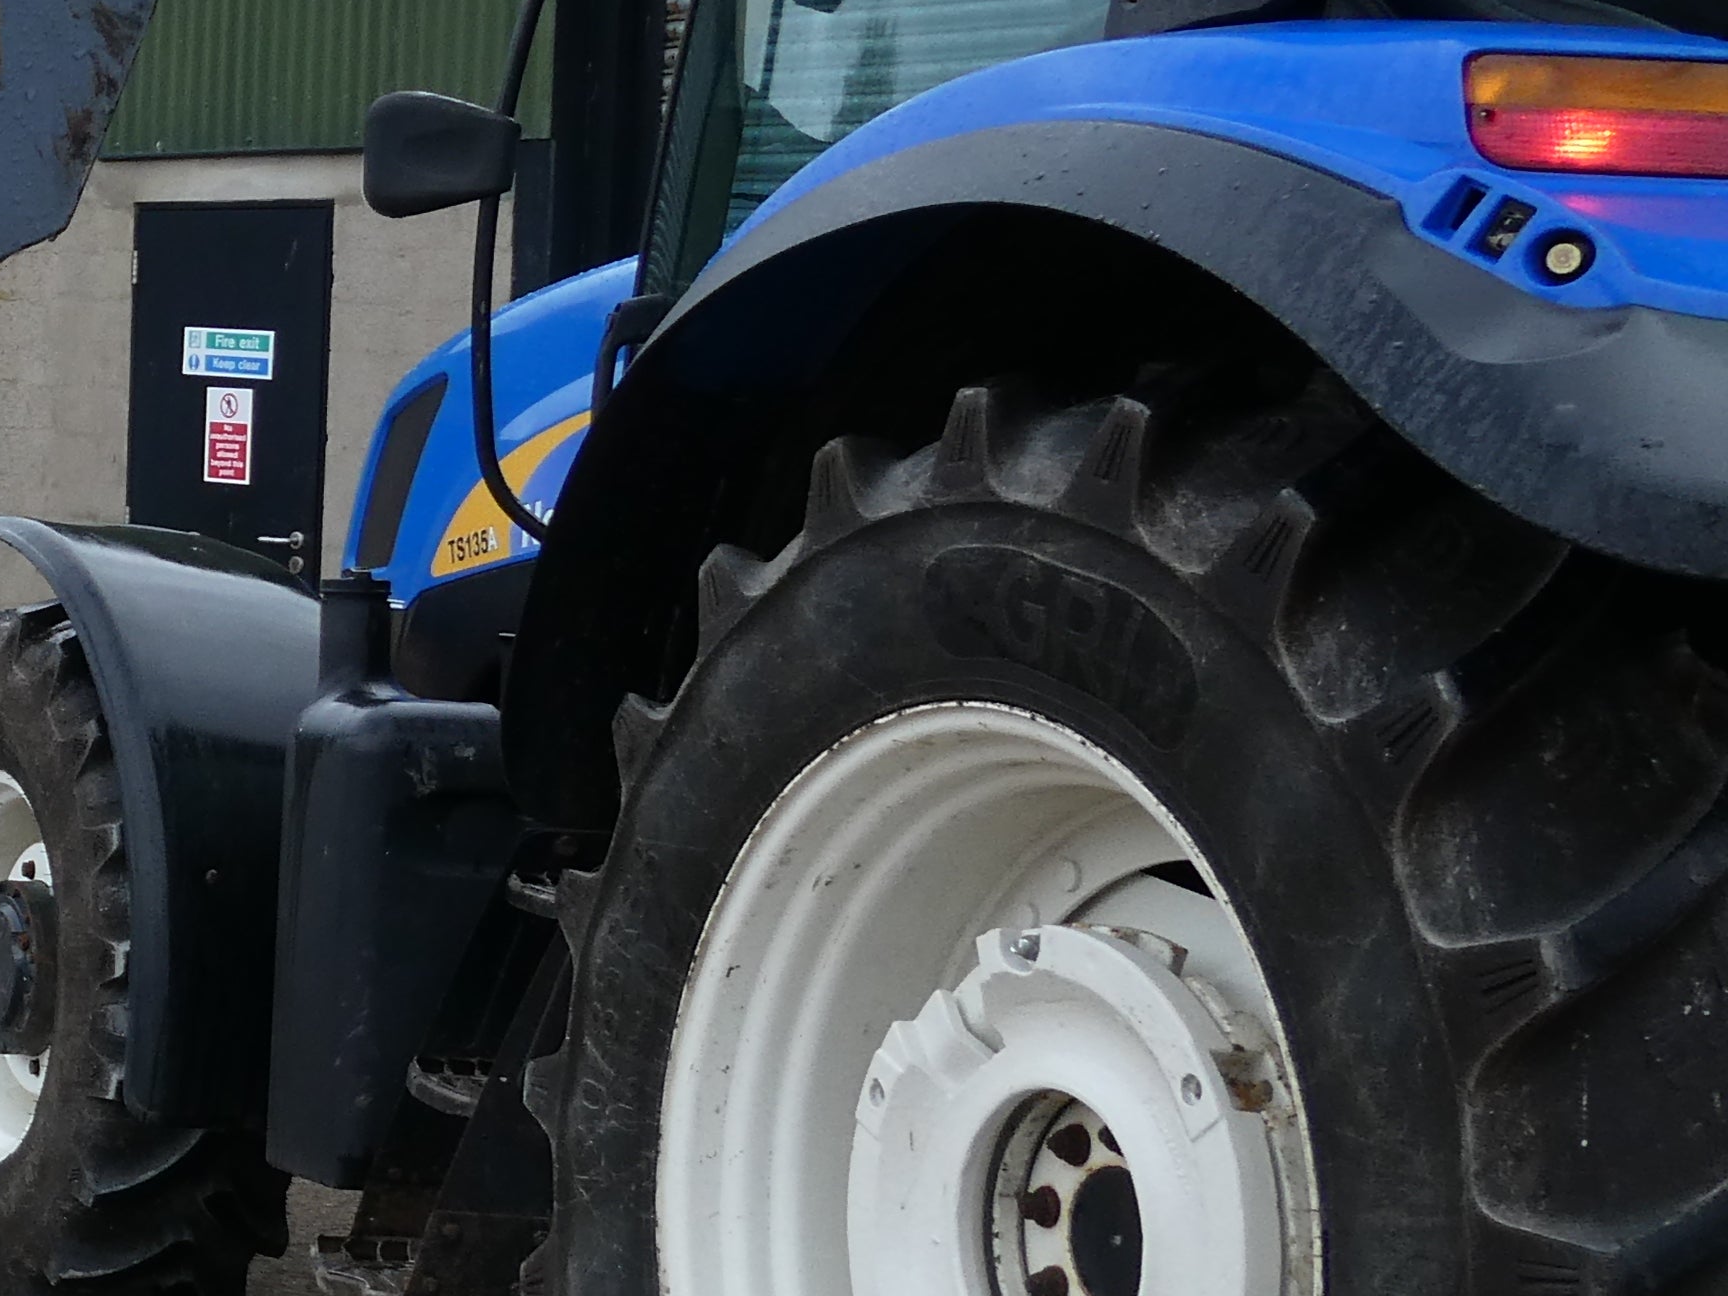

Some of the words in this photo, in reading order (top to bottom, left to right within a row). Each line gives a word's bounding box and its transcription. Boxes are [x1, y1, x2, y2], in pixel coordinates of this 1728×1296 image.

[215, 334, 236, 348] Fire
[239, 336, 261, 350] exit
[212, 357, 235, 371] Keep
[238, 359, 261, 371] clear
[447, 525, 499, 564] TS135A
